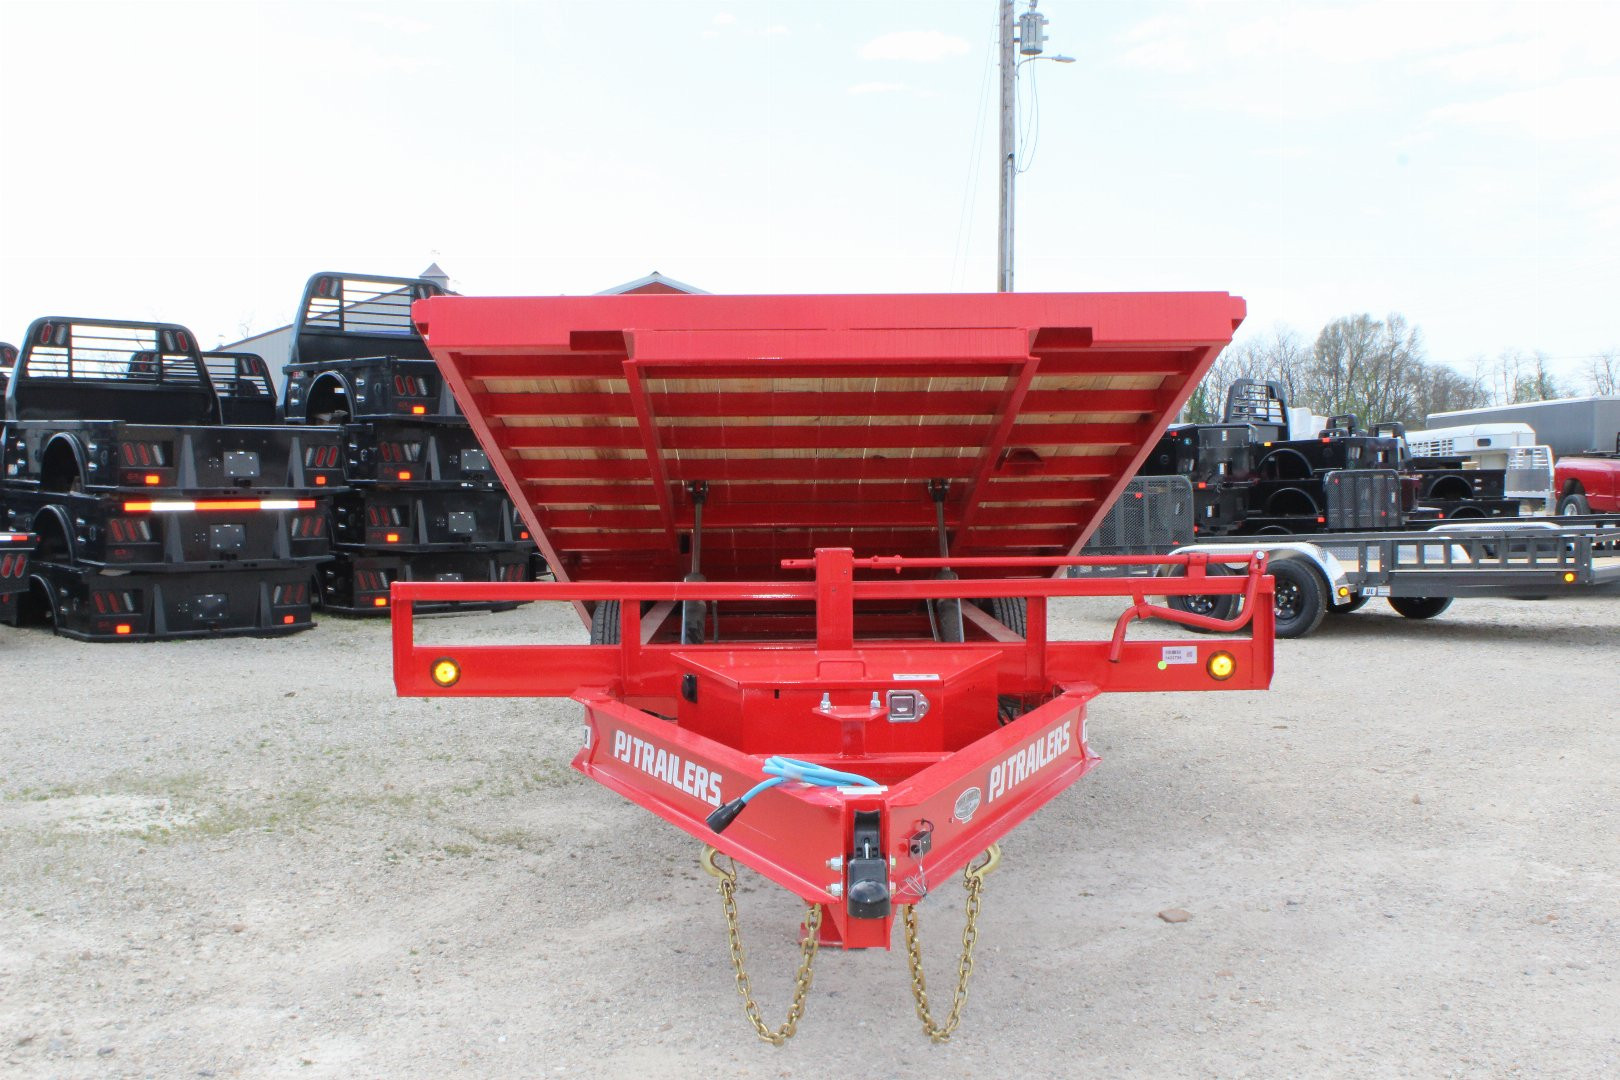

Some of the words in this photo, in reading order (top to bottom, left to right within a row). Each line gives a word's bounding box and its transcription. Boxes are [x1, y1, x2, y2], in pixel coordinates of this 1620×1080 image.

[614, 730, 632, 763] PJ
[633, 738, 722, 807] TRAILERS
[988, 761, 1006, 803] PJ
[1008, 720, 1070, 790] TRAILERS
